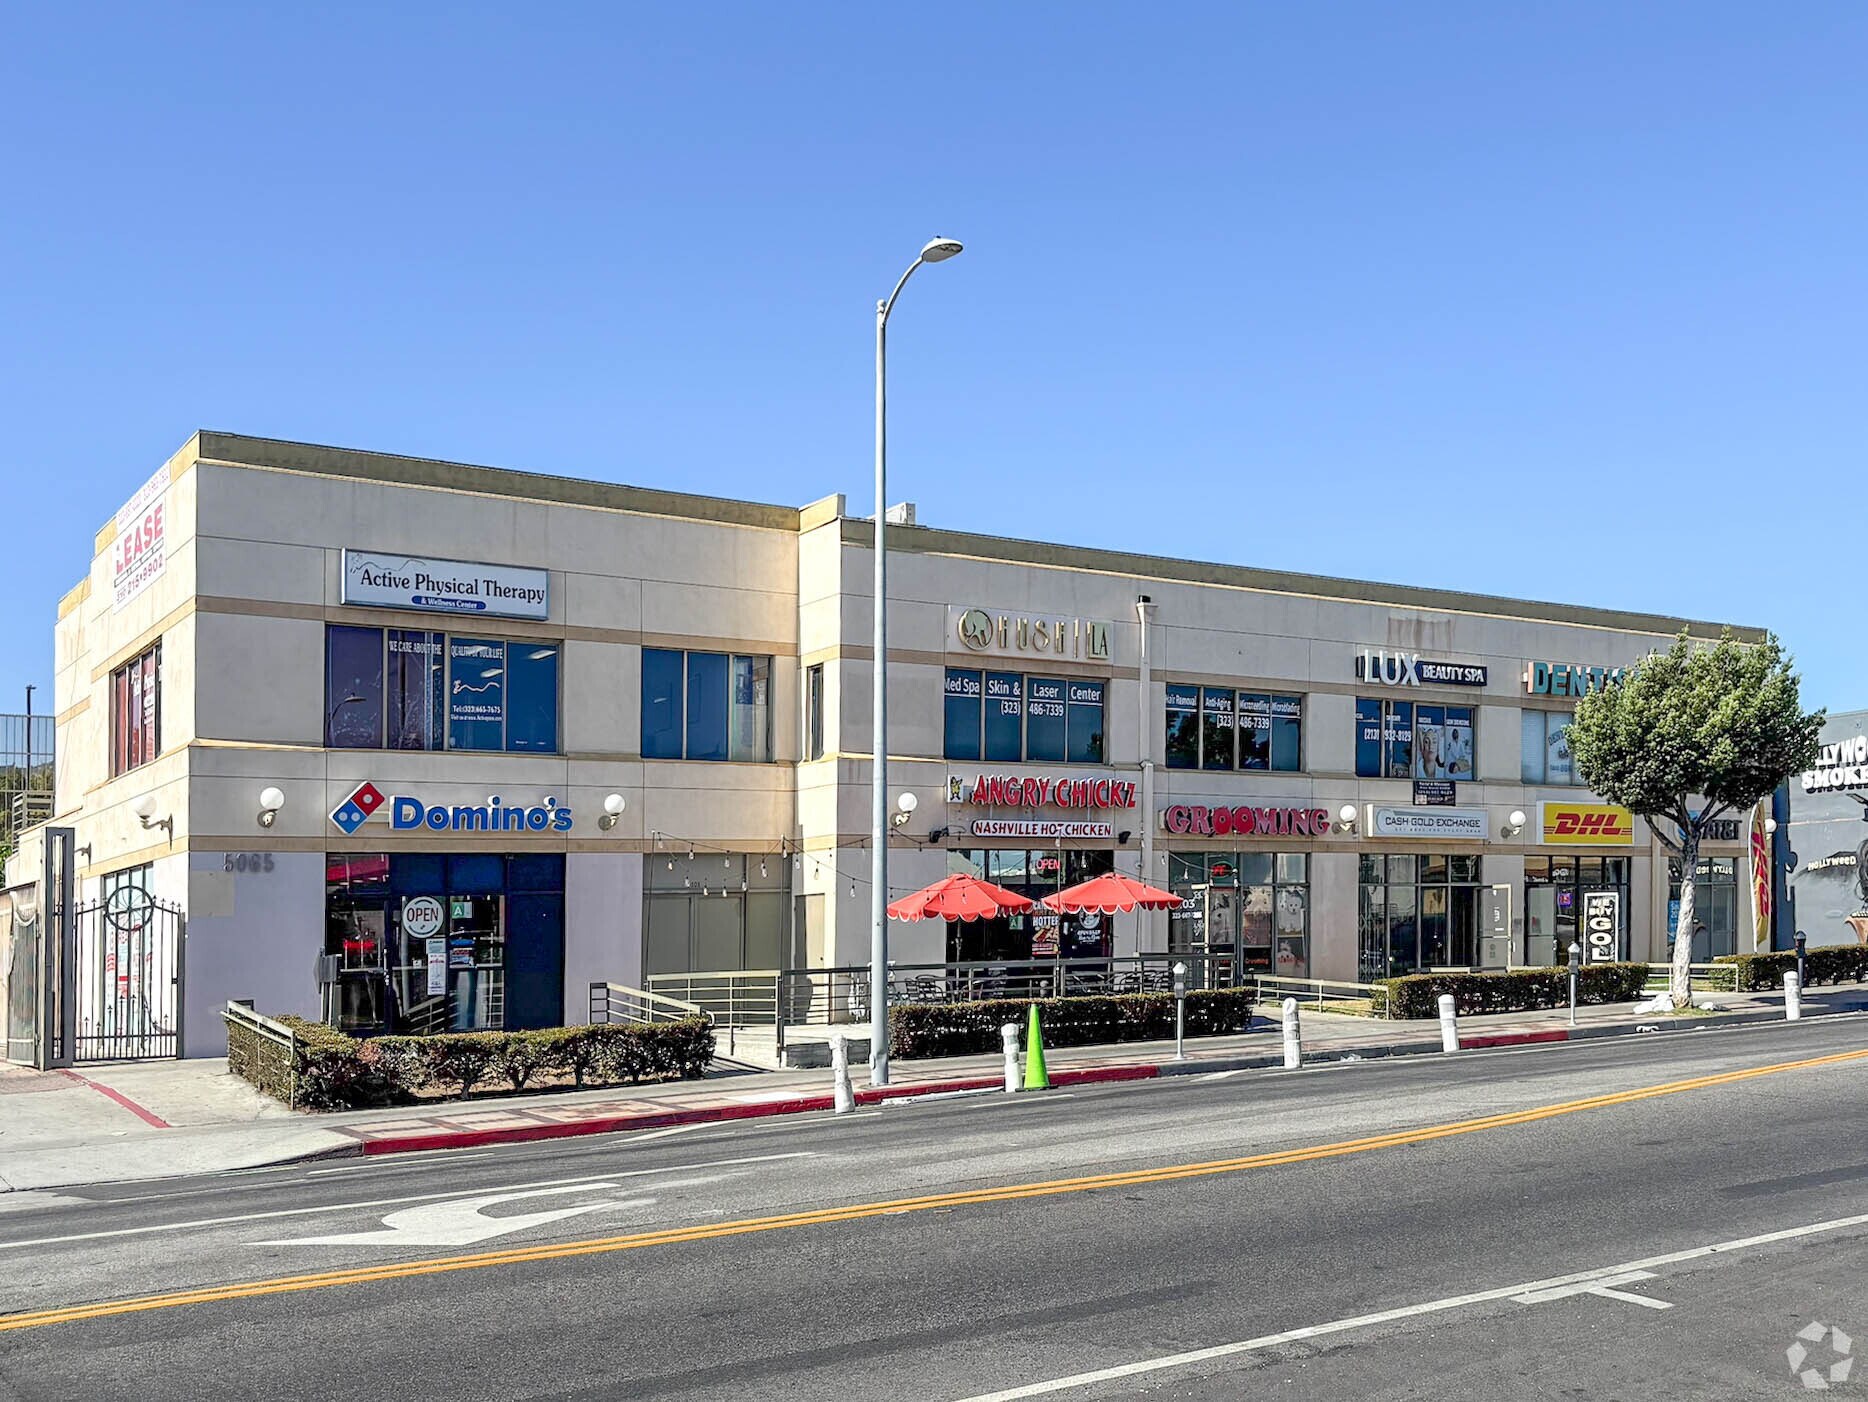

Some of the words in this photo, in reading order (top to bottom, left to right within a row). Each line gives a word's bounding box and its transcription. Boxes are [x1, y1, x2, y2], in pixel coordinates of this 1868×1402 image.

[360, 568, 410, 589] Active
[415, 573, 479, 596] Physical
[483, 579, 545, 604] Therapy
[428, 598, 456, 607] Wellness
[457, 600, 478, 609] Center
[1363, 649, 1420, 686] LUX
[1421, 664, 1464, 681] BEAUTY
[1464, 667, 1485, 682] SPA
[963, 678, 980, 695] Spa
[988, 679, 1009, 695] Skin
[1012, 681, 1021, 695] &
[1033, 683, 1059, 698] Laser
[1070, 686, 1101, 700] Center
[1001, 701, 1021, 716] (323)
[1028, 703, 1064, 717] 486-7339
[1216, 714, 1233, 728] (323)
[1239, 716, 1270, 729] 486-7339
[971, 775, 1050, 807] ANGRY
[1053, 777, 1136, 808] CHICKZ
[390, 795, 574, 832] Domino's
[1165, 805, 1331, 836] GROOMING
[1385, 816, 1409, 826] CASH
[1411, 817, 1434, 827] GOLD
[1436, 818, 1481, 828] EXCHANGE
[975, 821, 1038, 835] NASHVILLE
[1065, 823, 1112, 837] CHICKEN
[1554, 812, 1622, 836] DHL
[1036, 858, 1060, 870] OPEN
[406, 907, 439, 922] OPEN
[453, 906, 463, 916] A
[1589, 917, 1613, 965] GOL
